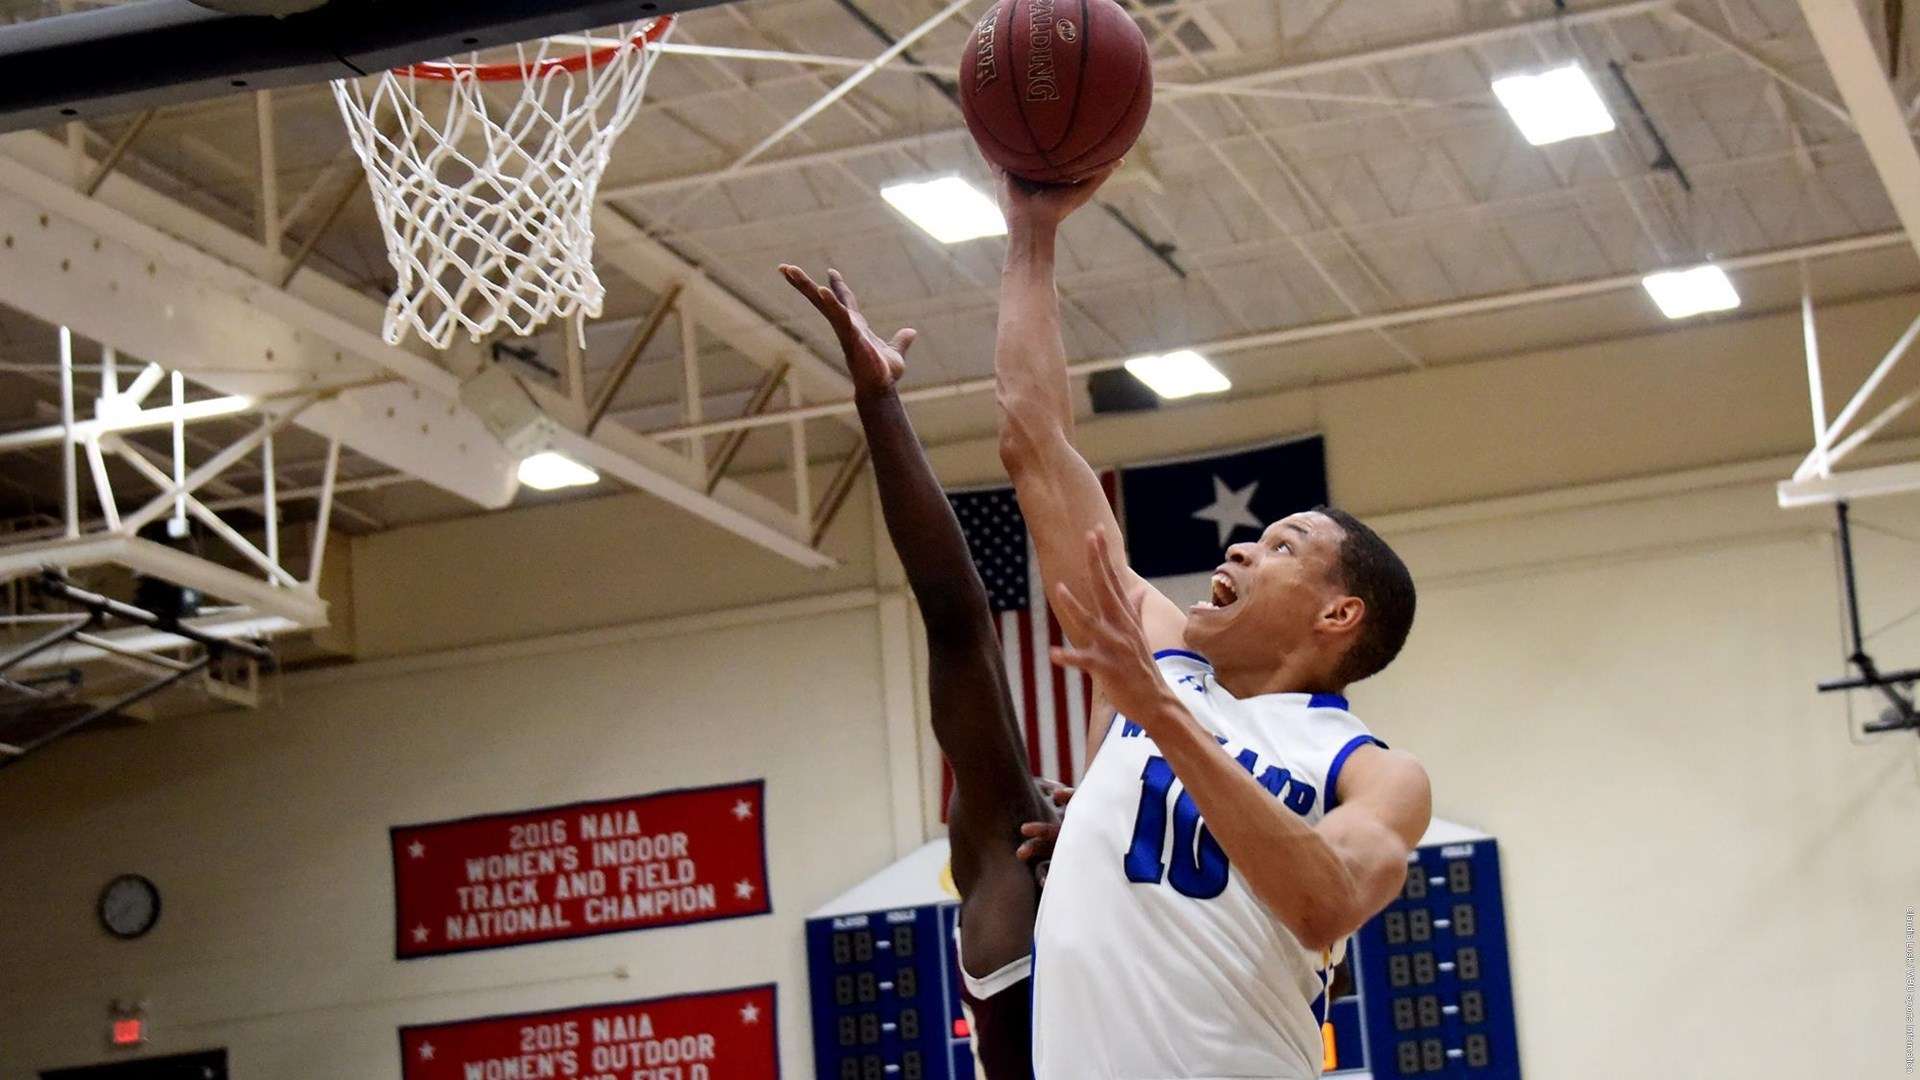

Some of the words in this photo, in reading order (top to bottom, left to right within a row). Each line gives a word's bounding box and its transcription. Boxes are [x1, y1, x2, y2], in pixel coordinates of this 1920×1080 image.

[1121, 719, 1317, 816] WAND
[509, 819, 567, 850] 2016
[580, 810, 641, 839] NAIA
[1124, 755, 1229, 900] 10
[465, 846, 578, 881] WOMEN'S
[592, 832, 688, 867] INDOOR
[457, 879, 539, 910] TRACK
[555, 870, 606, 899] AND
[620, 859, 696, 892] FIELD
[446, 903, 571, 941] NATIONAL
[584, 883, 716, 925] CHAMPION
[464, 1049, 578, 1080] WOMEN'S
[592, 1033, 715, 1072] OUTDOOR
[520, 1021, 580, 1051] 2015
[592, 1013, 654, 1043] NAIA
